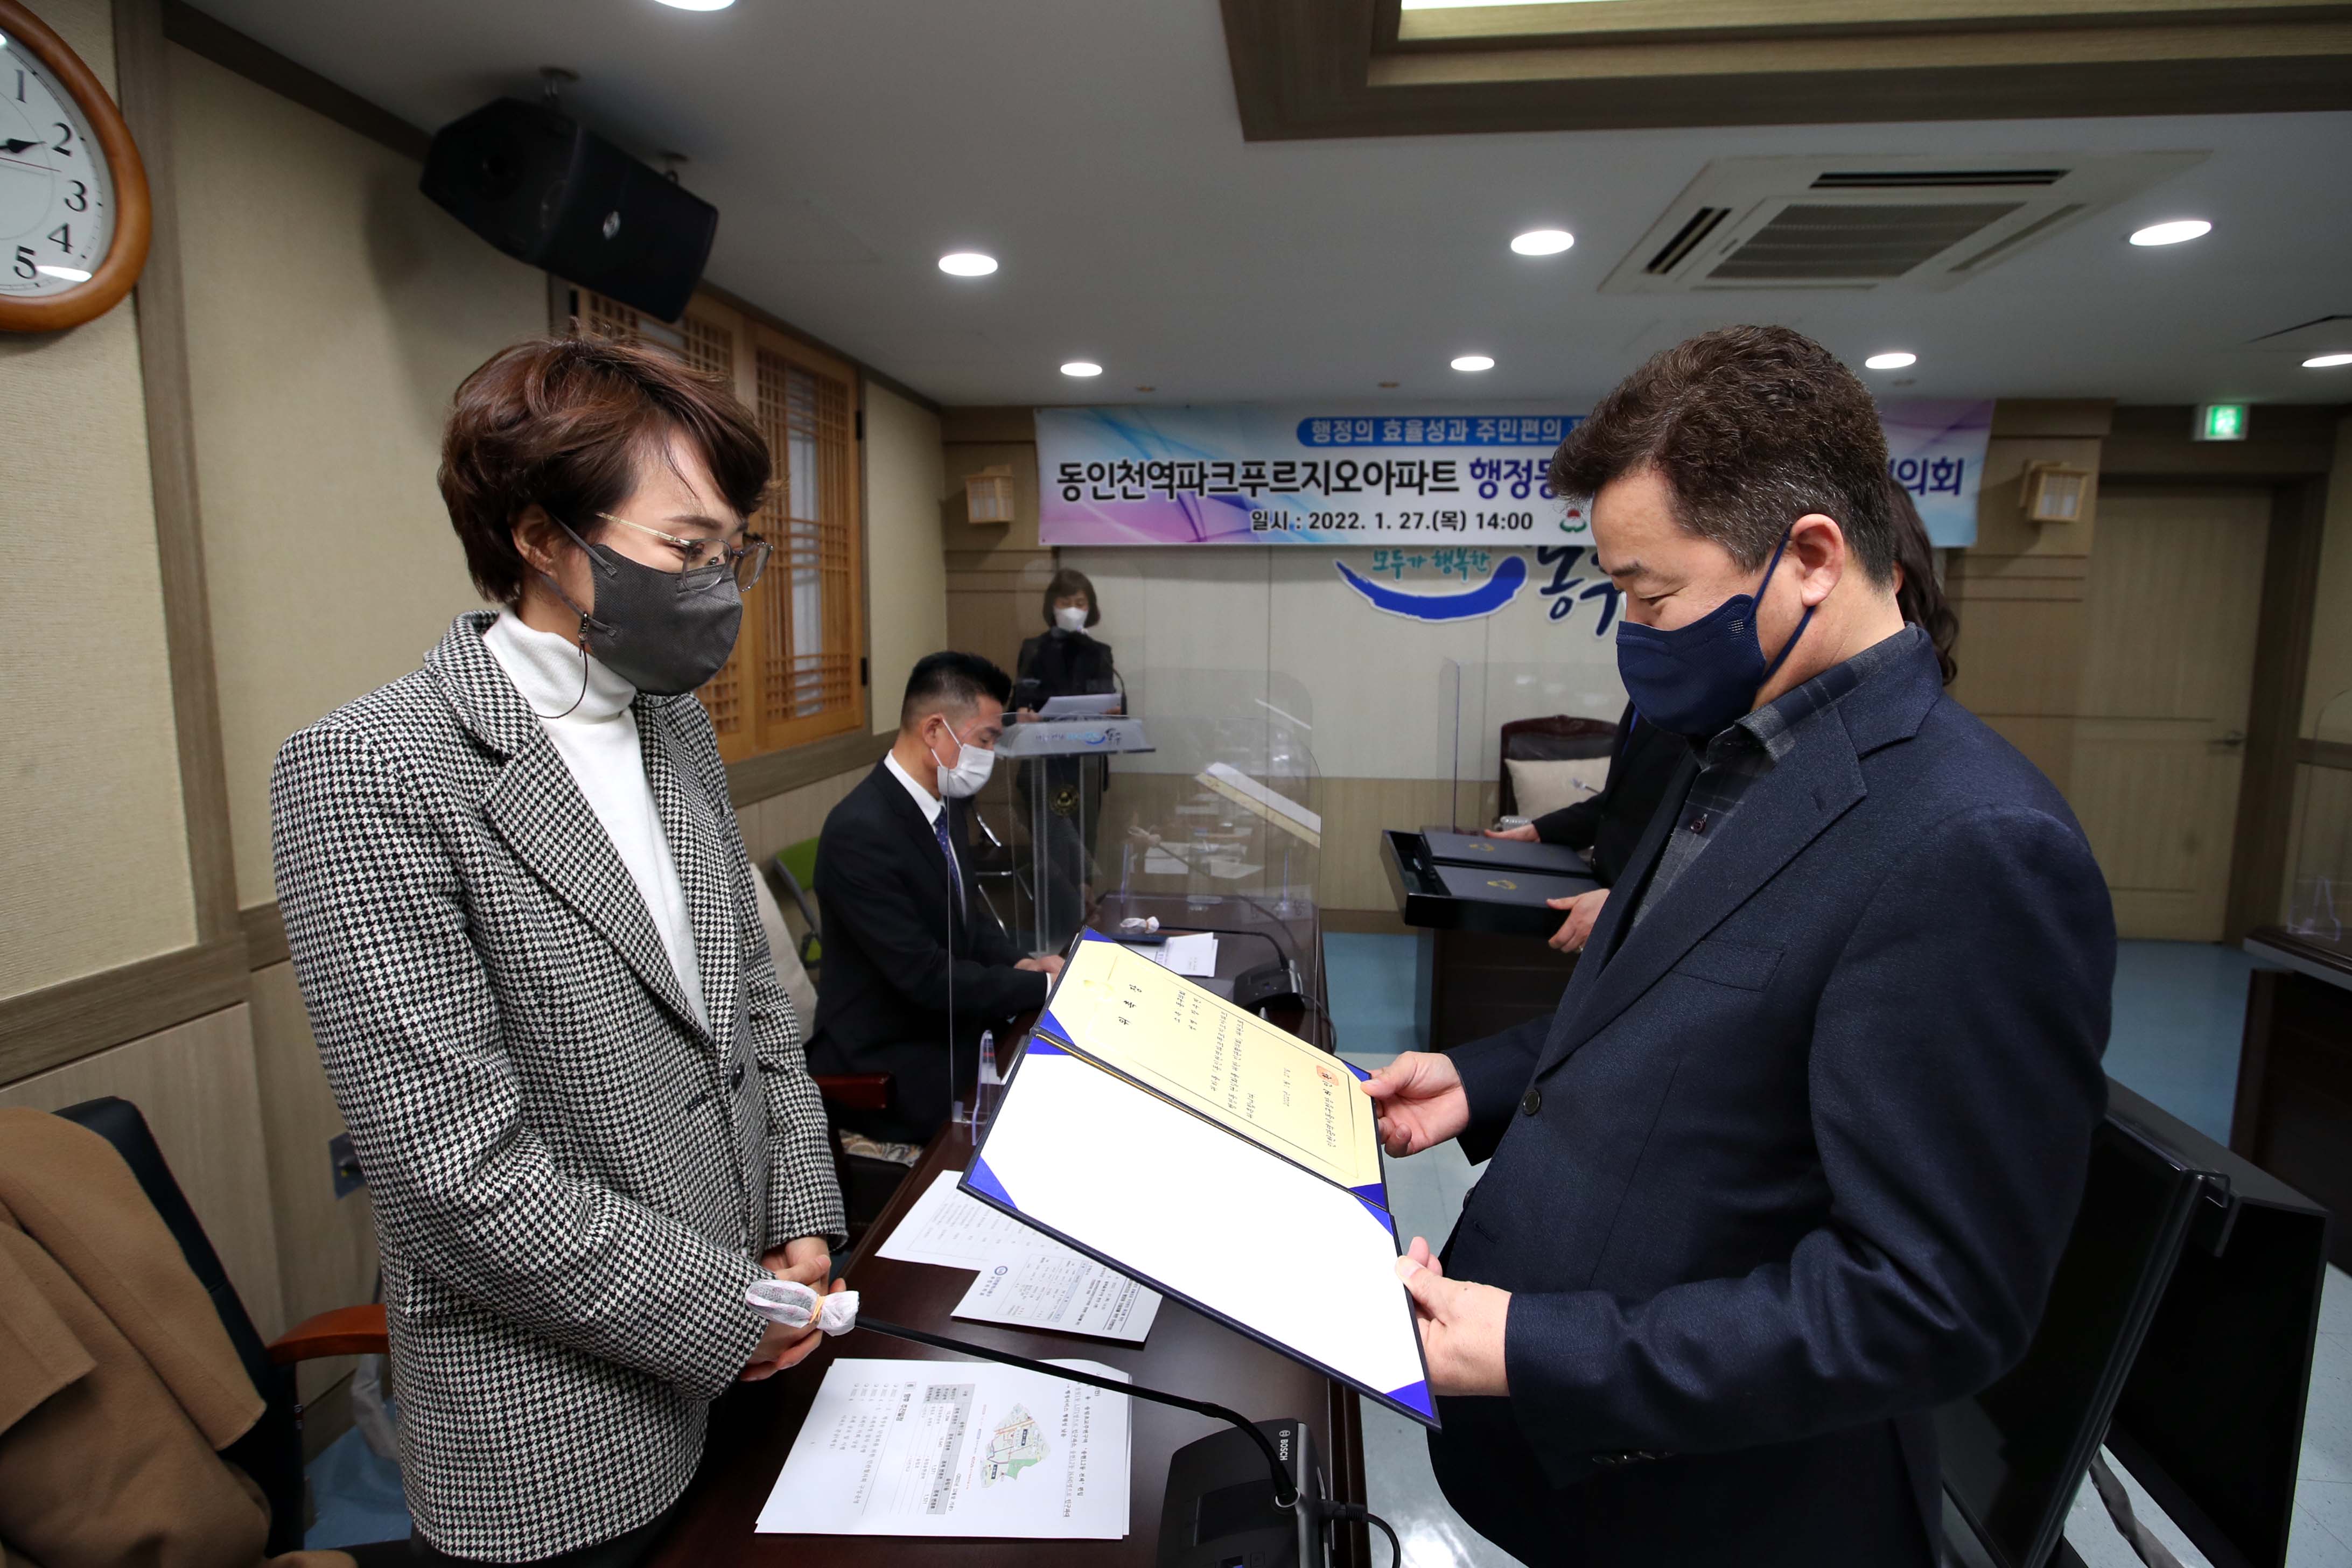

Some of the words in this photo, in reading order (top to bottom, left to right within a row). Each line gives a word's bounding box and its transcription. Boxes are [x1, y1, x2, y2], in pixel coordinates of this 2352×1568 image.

[16, 69, 26, 103] 1
[52, 122, 73, 156] 2
[65, 179, 87, 212] 3
[47, 223, 73, 254] 4
[13, 245, 37, 279] 5
[1311, 419, 1373, 443] 행정의
[1382, 419, 1468, 443] 효율성과
[1476, 418, 1561, 442] 주민편의
[1057, 459, 1460, 501] 동인천역파크푸르지오아파트
[1888, 457, 1964, 496] 의회
[1251, 510, 1288, 530] 일시
[1309, 512, 1366, 530] 2022.
[1476, 512, 1534, 530] 14:00
[1372, 549, 1427, 580] 모두가
[1431, 549, 1491, 580] 행복한
[1279, 1438, 1289, 1461] BOSCH
